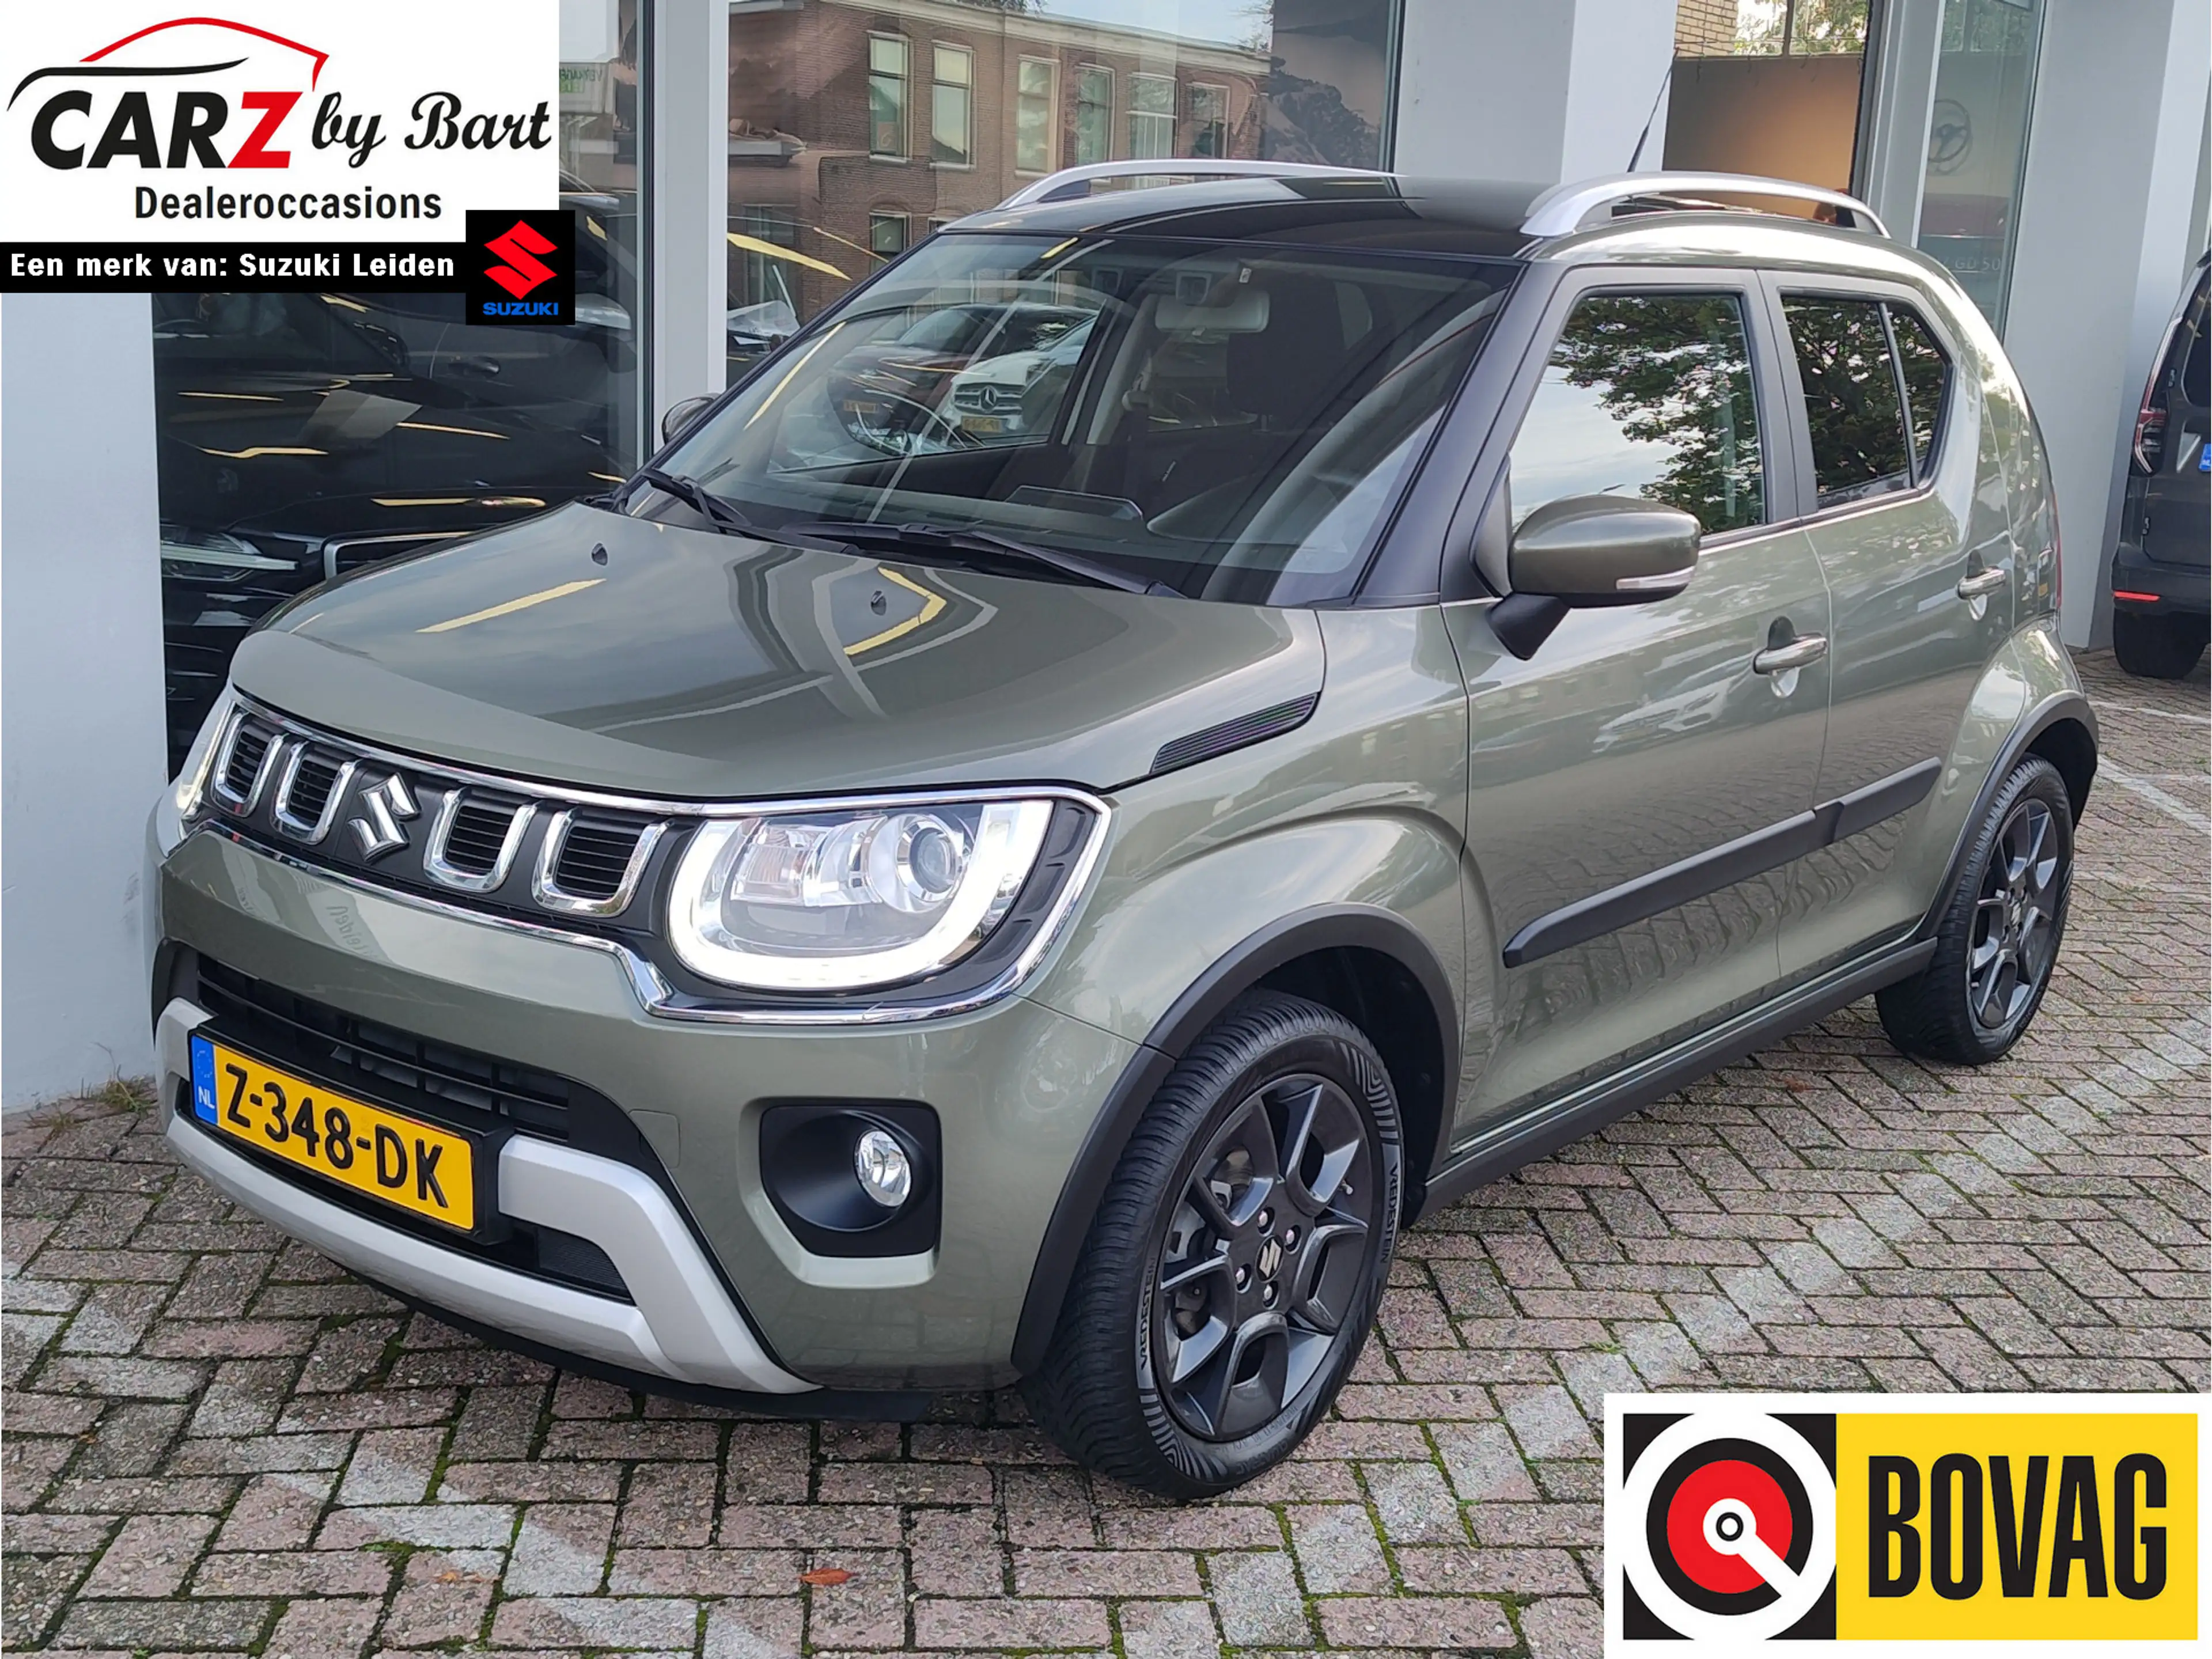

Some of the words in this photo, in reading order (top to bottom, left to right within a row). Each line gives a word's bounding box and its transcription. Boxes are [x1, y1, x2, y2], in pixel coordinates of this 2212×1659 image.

[198, 1085, 215, 1110] NL
[225, 1062, 449, 1209] Z-348-DK
[1380, 1161, 1400, 1264] VREDESTEIN
[1139, 1257, 1156, 1371] VREDESTEIN
